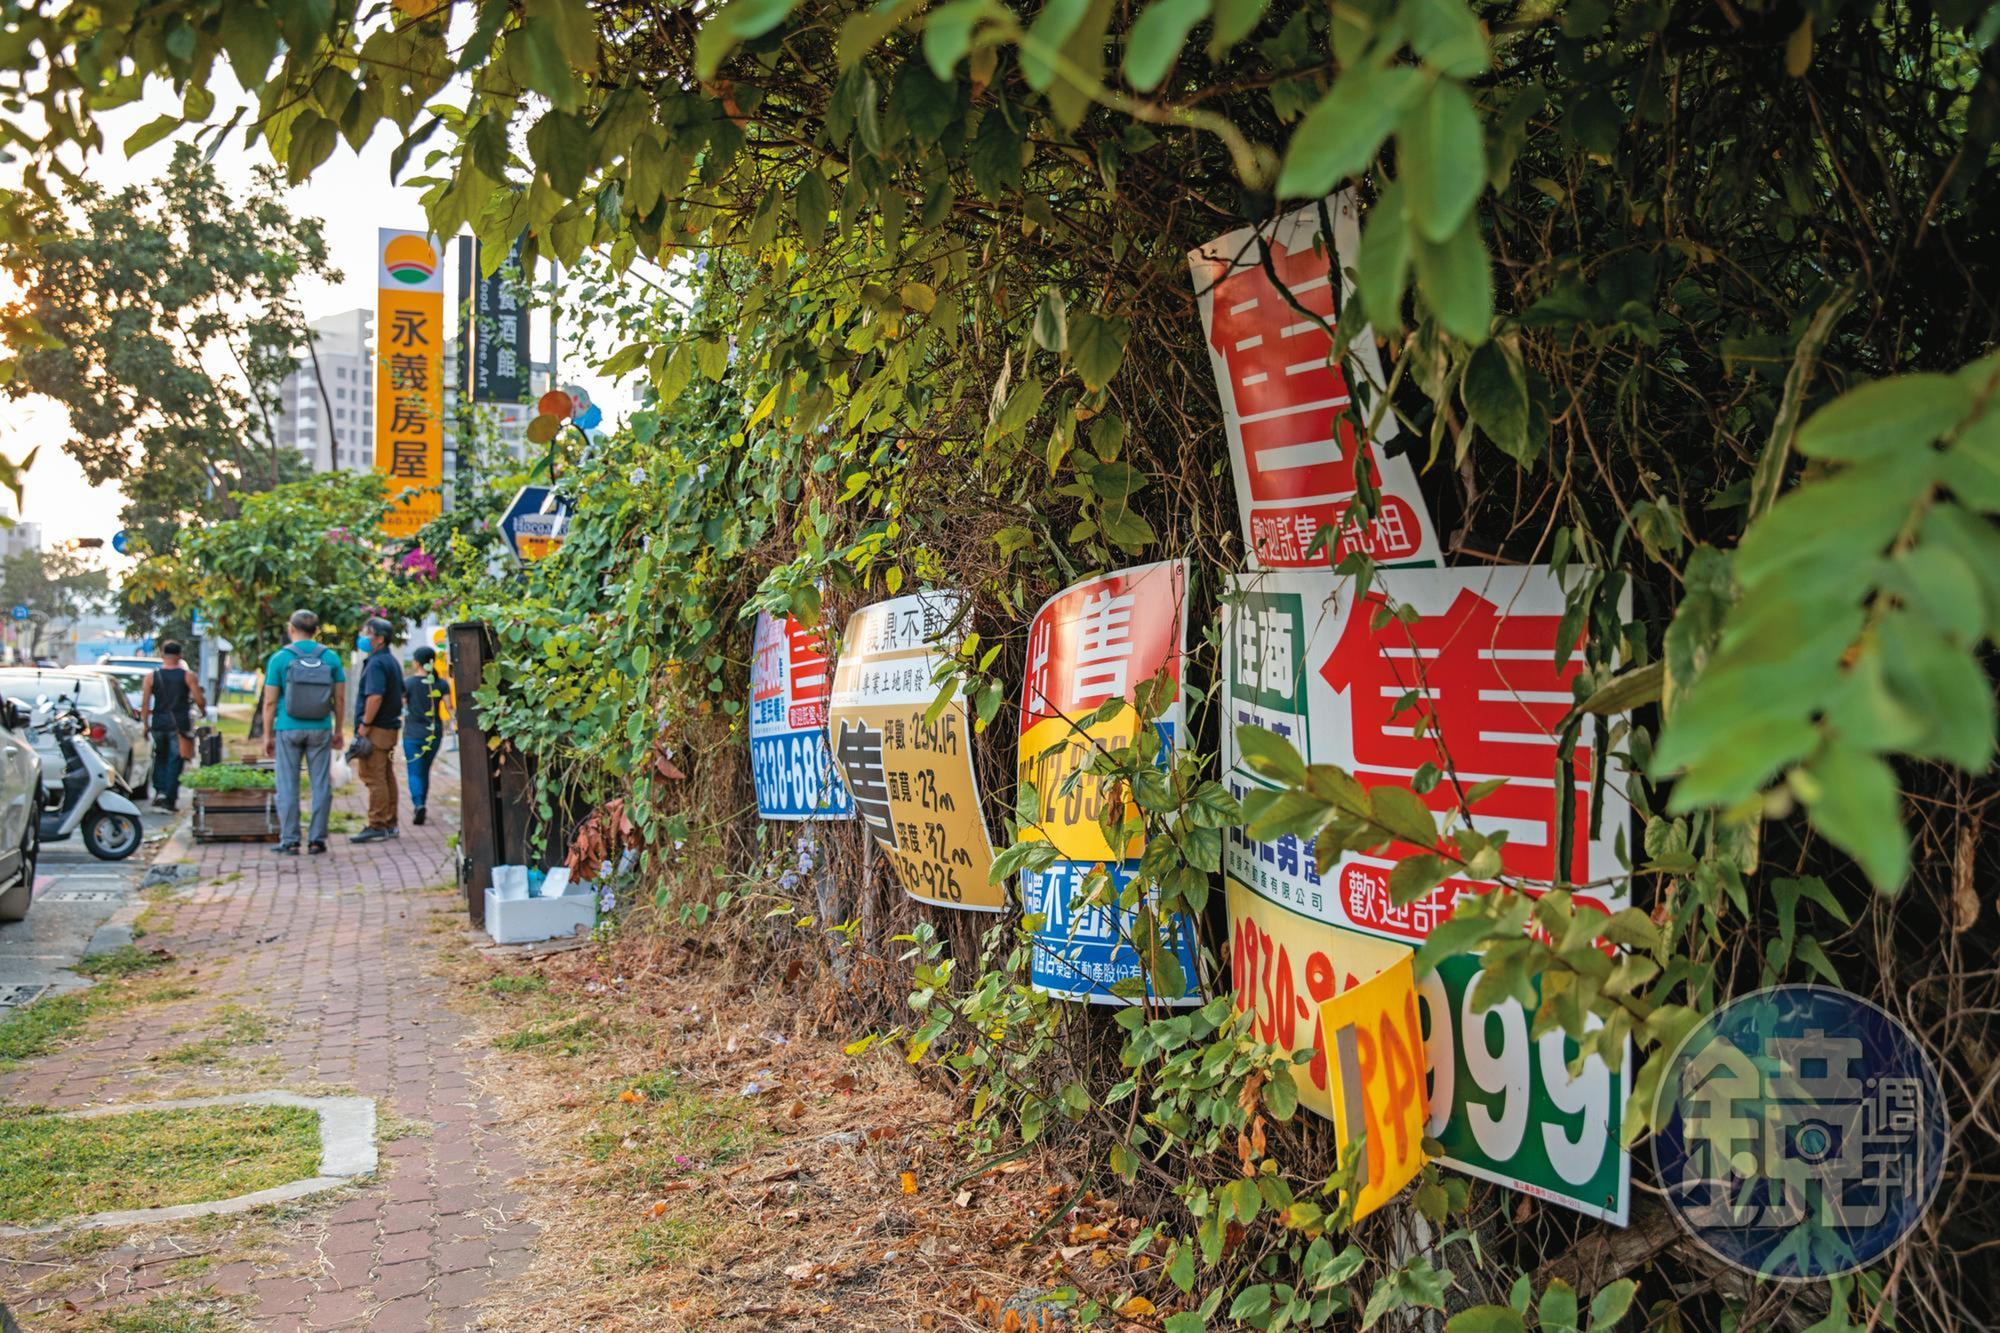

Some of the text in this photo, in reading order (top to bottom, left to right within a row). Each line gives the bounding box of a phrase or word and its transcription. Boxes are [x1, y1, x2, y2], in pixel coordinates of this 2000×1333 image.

[391, 309, 430, 479] 永義房屋
[478, 319, 491, 364] offee.
[478, 366, 490, 389] Art
[1210, 236, 1383, 501] 售
[866, 606, 959, 652] 鼎不動
[1028, 590, 1136, 724] 出售
[1236, 609, 1294, 700] 住商
[837, 717, 899, 851] 售
[1319, 587, 1592, 885] 售
[1233, 916, 1381, 1091] 0930-9
